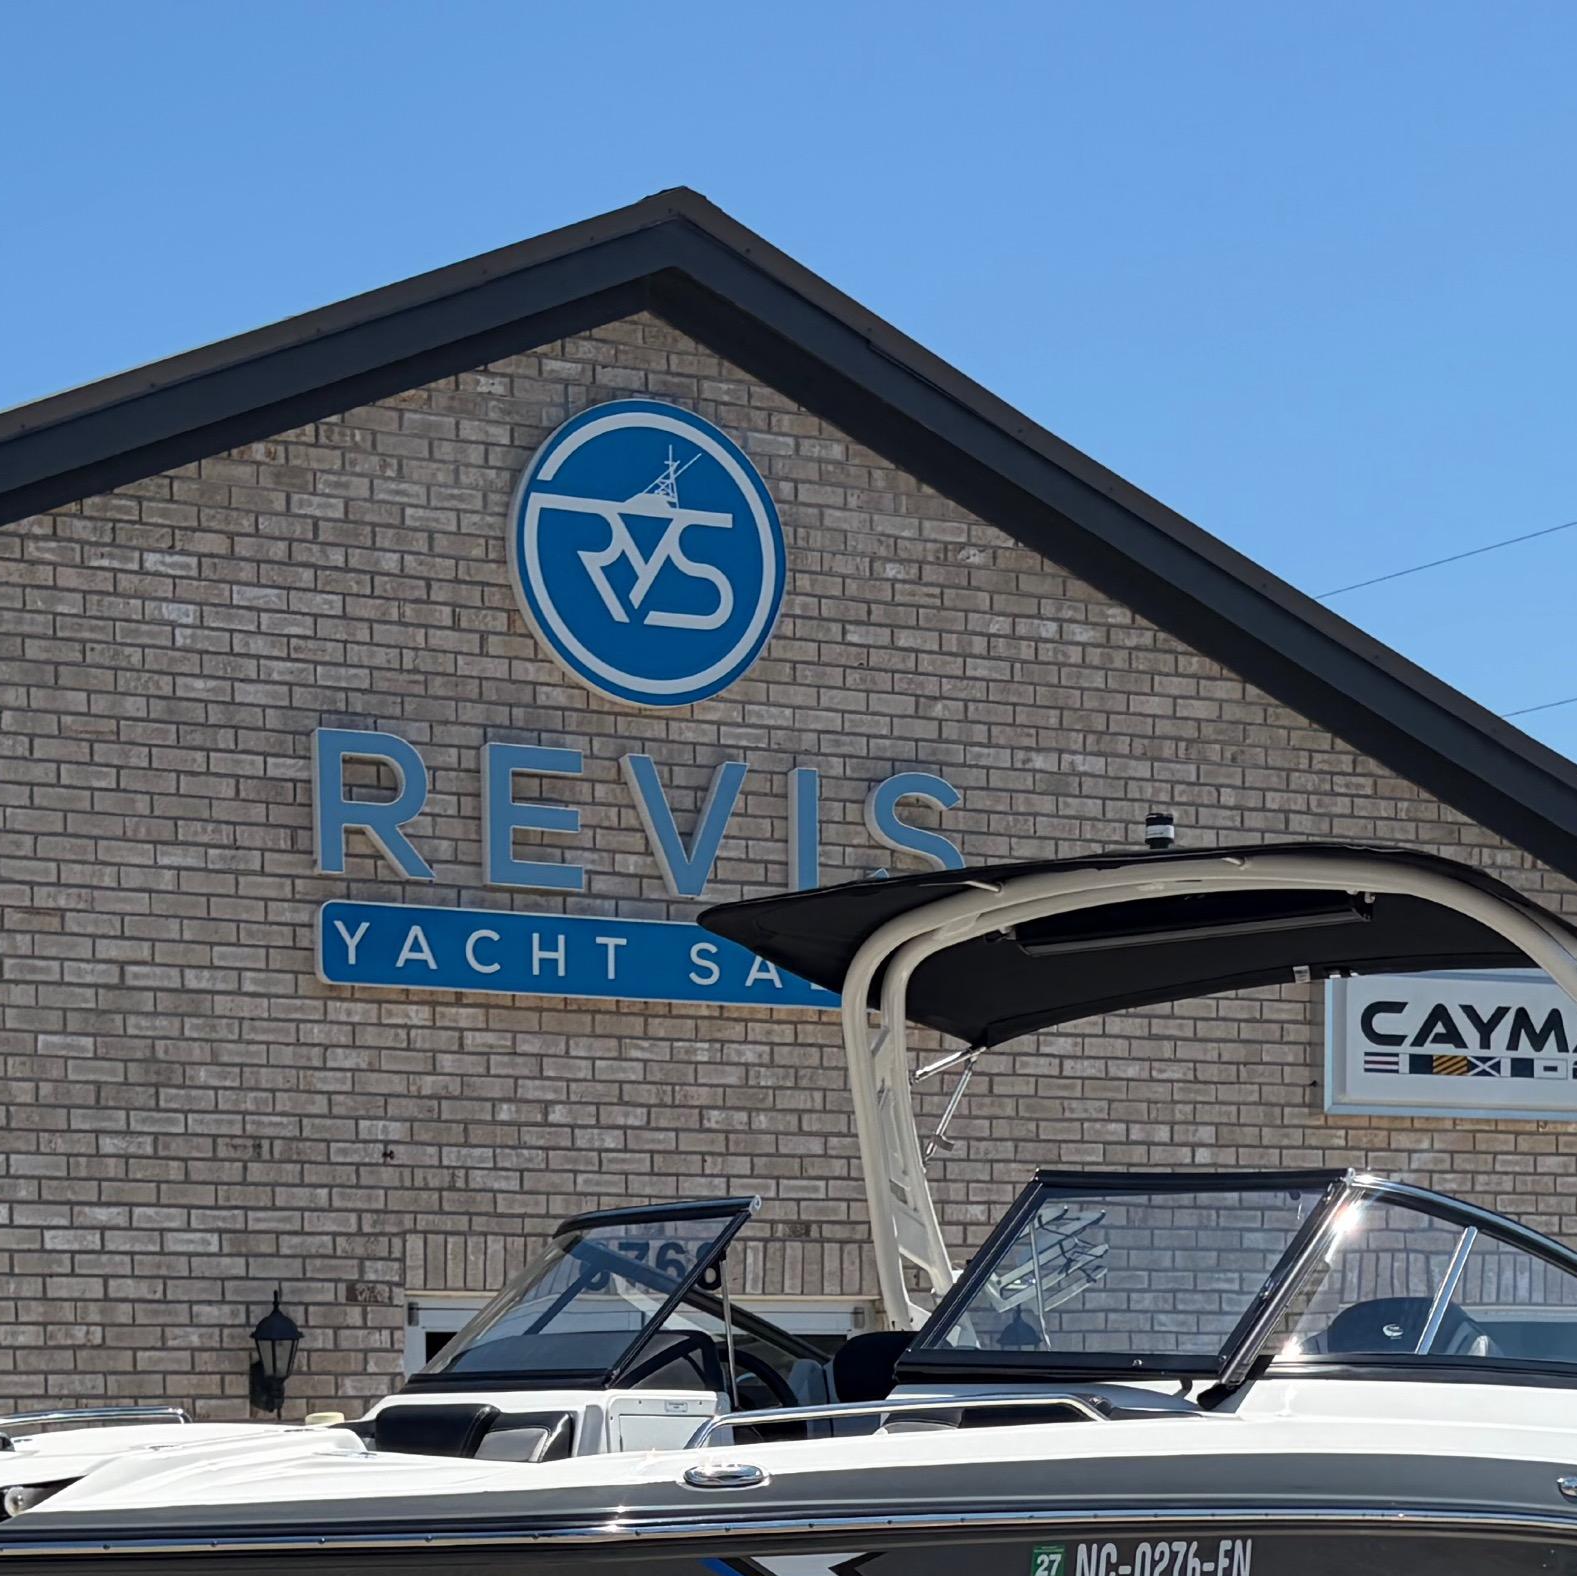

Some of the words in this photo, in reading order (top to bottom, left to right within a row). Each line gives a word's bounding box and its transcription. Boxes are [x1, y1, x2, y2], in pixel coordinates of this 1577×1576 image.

[310, 727, 966, 898] REVIS
[334, 920, 628, 981] YACHT
[689, 942, 828, 991] SA
[1034, 1553, 1062, 1576] 27
